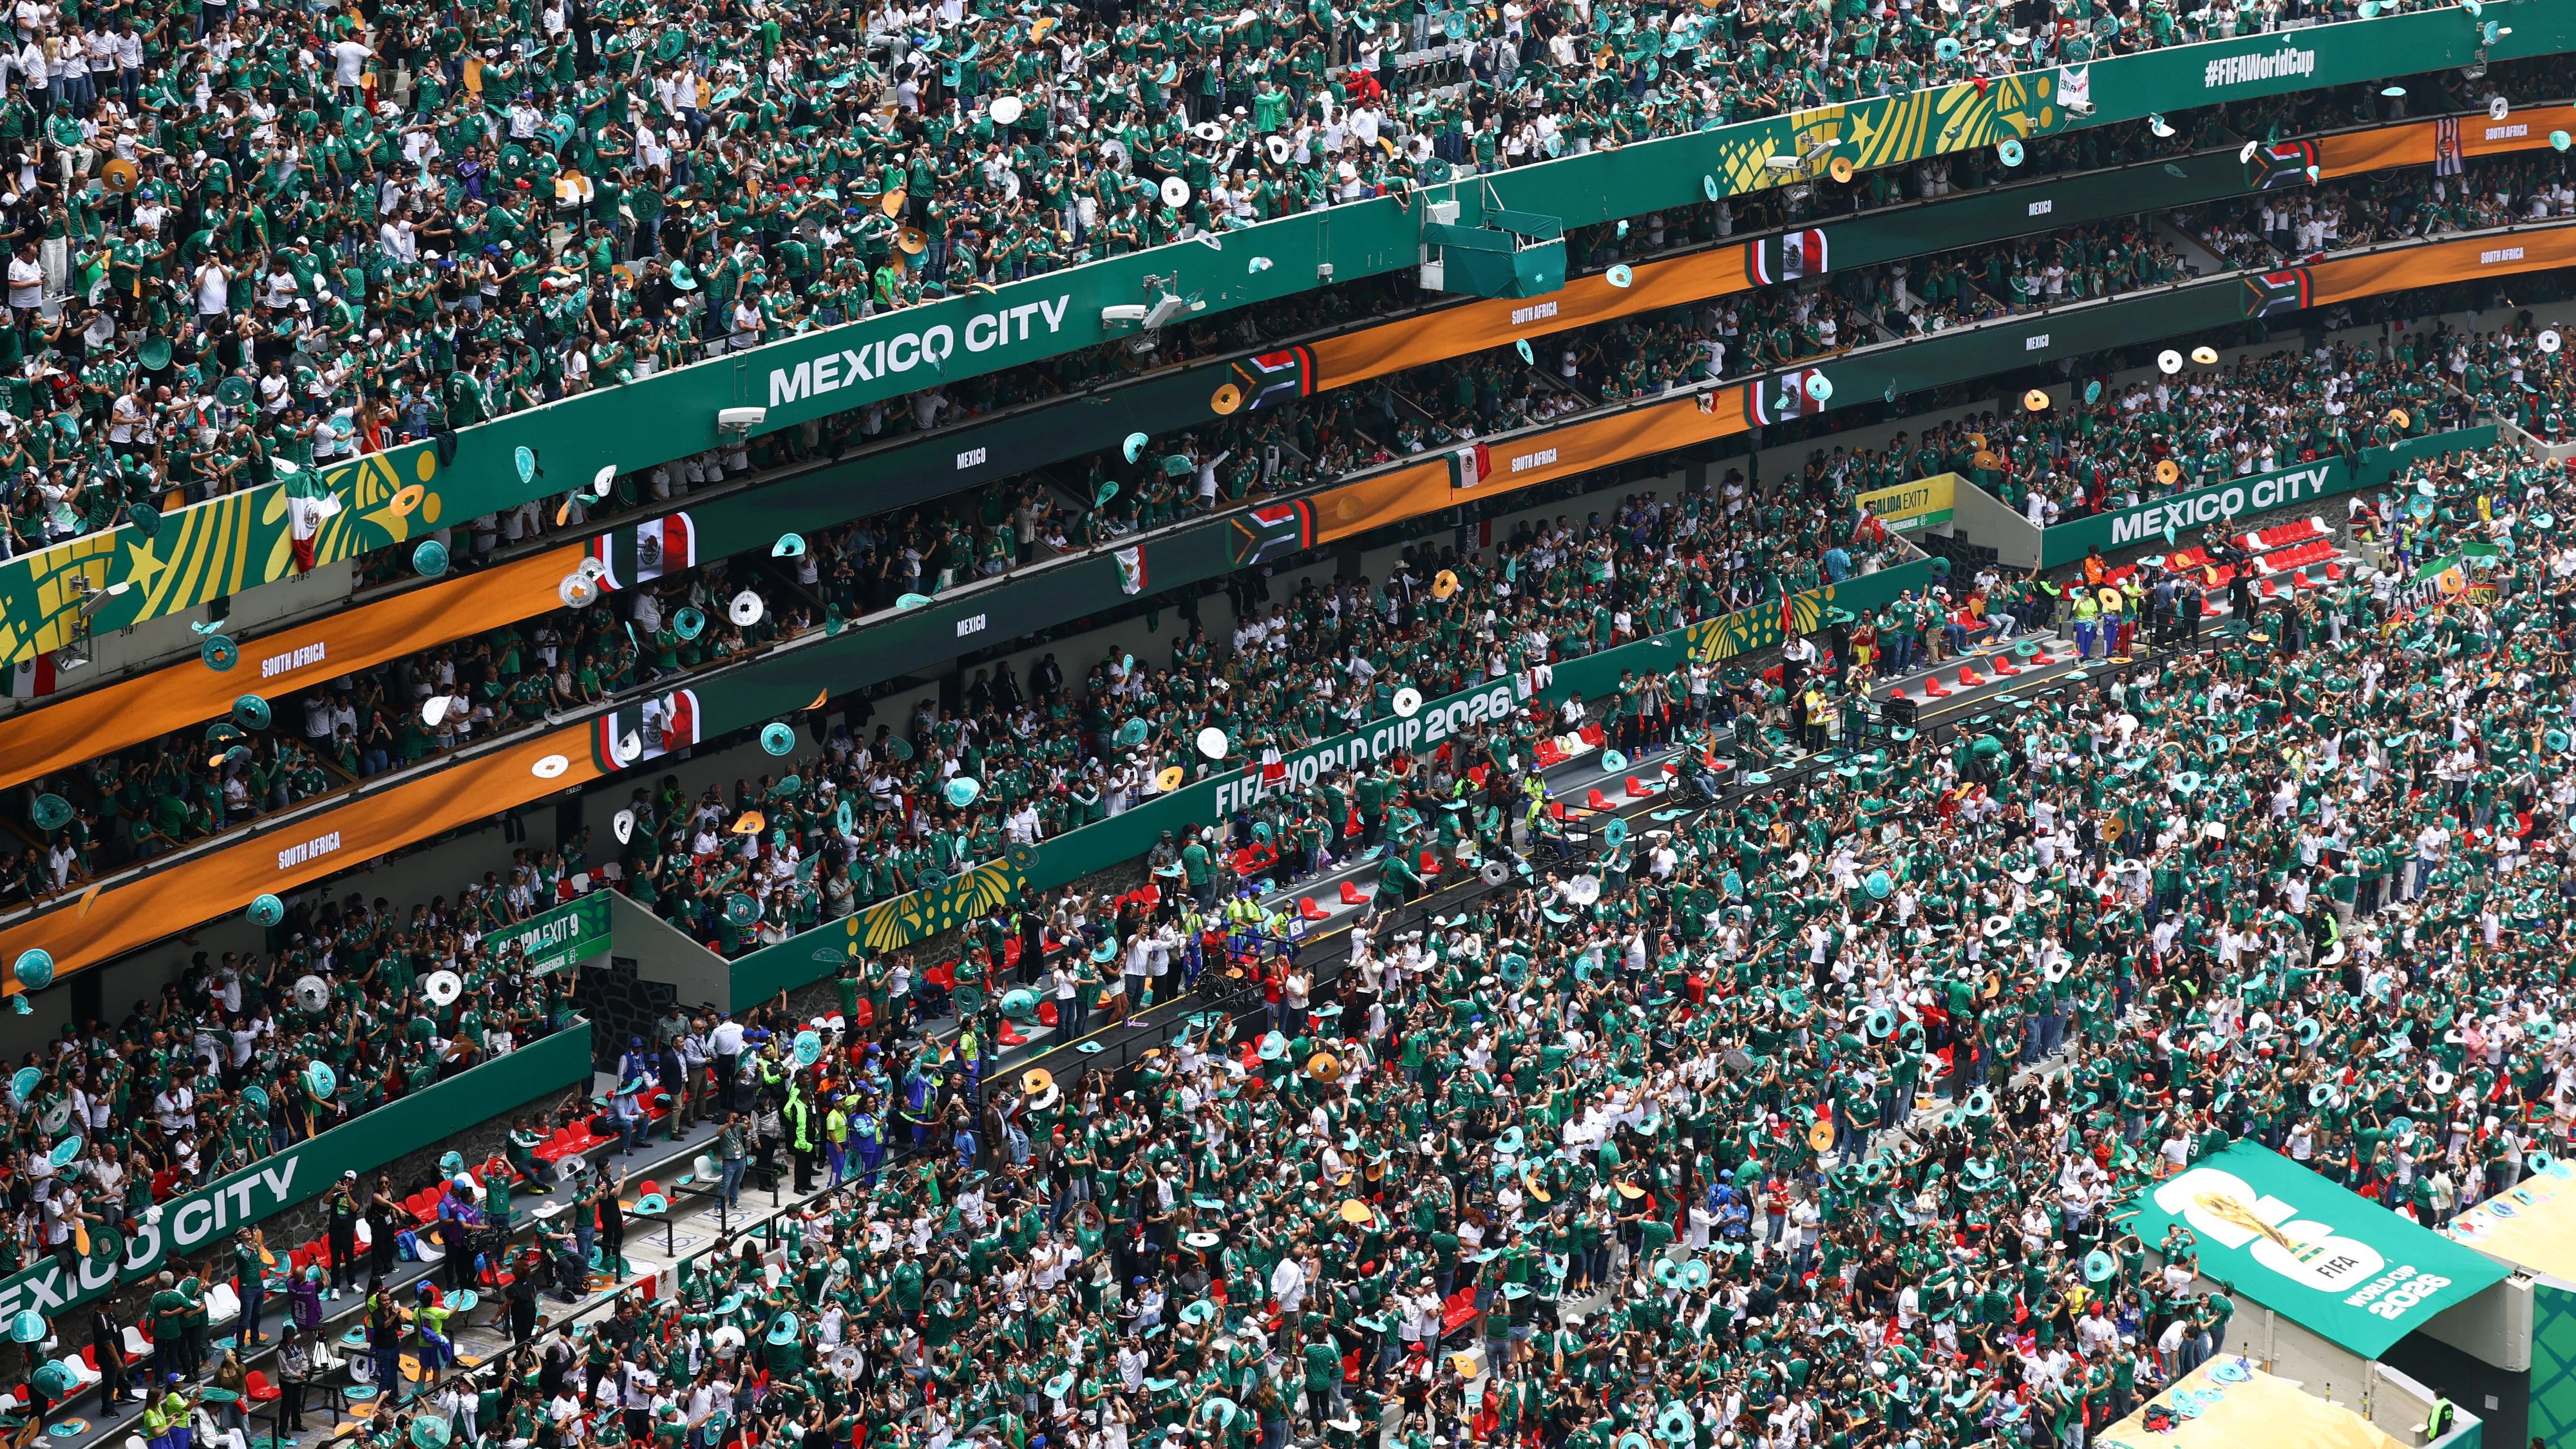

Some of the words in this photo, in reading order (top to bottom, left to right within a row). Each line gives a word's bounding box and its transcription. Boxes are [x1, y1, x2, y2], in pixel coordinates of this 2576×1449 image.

[2204, 48, 2315, 88] #FIFAWorldCup
[2485, 127, 2505, 140] SOUTH
[2506, 124, 2528, 138] AFRICA
[2029, 200, 2052, 216] MEXICO
[2481, 251, 2501, 264] SOUTH
[2501, 247, 2524, 261] AFRICA
[1511, 307, 1533, 325] SOUTH
[1534, 301, 1557, 320] AFRICA
[770, 325, 954, 408] MEXICO
[965, 294, 1070, 352] CITY
[2026, 334, 2049, 351] MEXICO
[957, 447, 986, 470] MEXICO
[1511, 455, 1533, 473] SOUTH
[1533, 448, 1557, 467] AFRICA
[1872, 495, 1901, 515] SALIDA
[1903, 490, 1922, 509] EXIT
[1923, 488, 1929, 505] 7
[2112, 488, 2244, 544] MEXICO
[2252, 466, 2329, 507] CITY
[1891, 518, 1918, 530] EMERGENCIA
[957, 614, 986, 638] MEXICO
[262, 652, 291, 678] SOUTH
[292, 642, 325, 668] AFRICA
[1217, 772, 1270, 818] FIFA
[1282, 738, 1368, 793] WORLD
[1372, 718, 1421, 762] CUP
[1426, 687, 1511, 743] 2026
[307, 783, 312, 791] 8
[278, 843, 307, 869] SOUTH
[308, 831, 341, 859] AFRICA
[498, 929, 540, 965] SIDA
[542, 917, 568, 948] EXIT
[570, 913, 578, 936] 9
[2190, 1144, 2199, 1156] 9
[0, 1224, 160, 1333] EXICO
[173, 1156, 298, 1245] CITY
[2316, 1256, 2360, 1279] FIFA
[2343, 1277, 2396, 1307] WORLD
[2387, 1265, 2418, 1281] CUP
[2368, 1273, 2452, 1320] 2026
